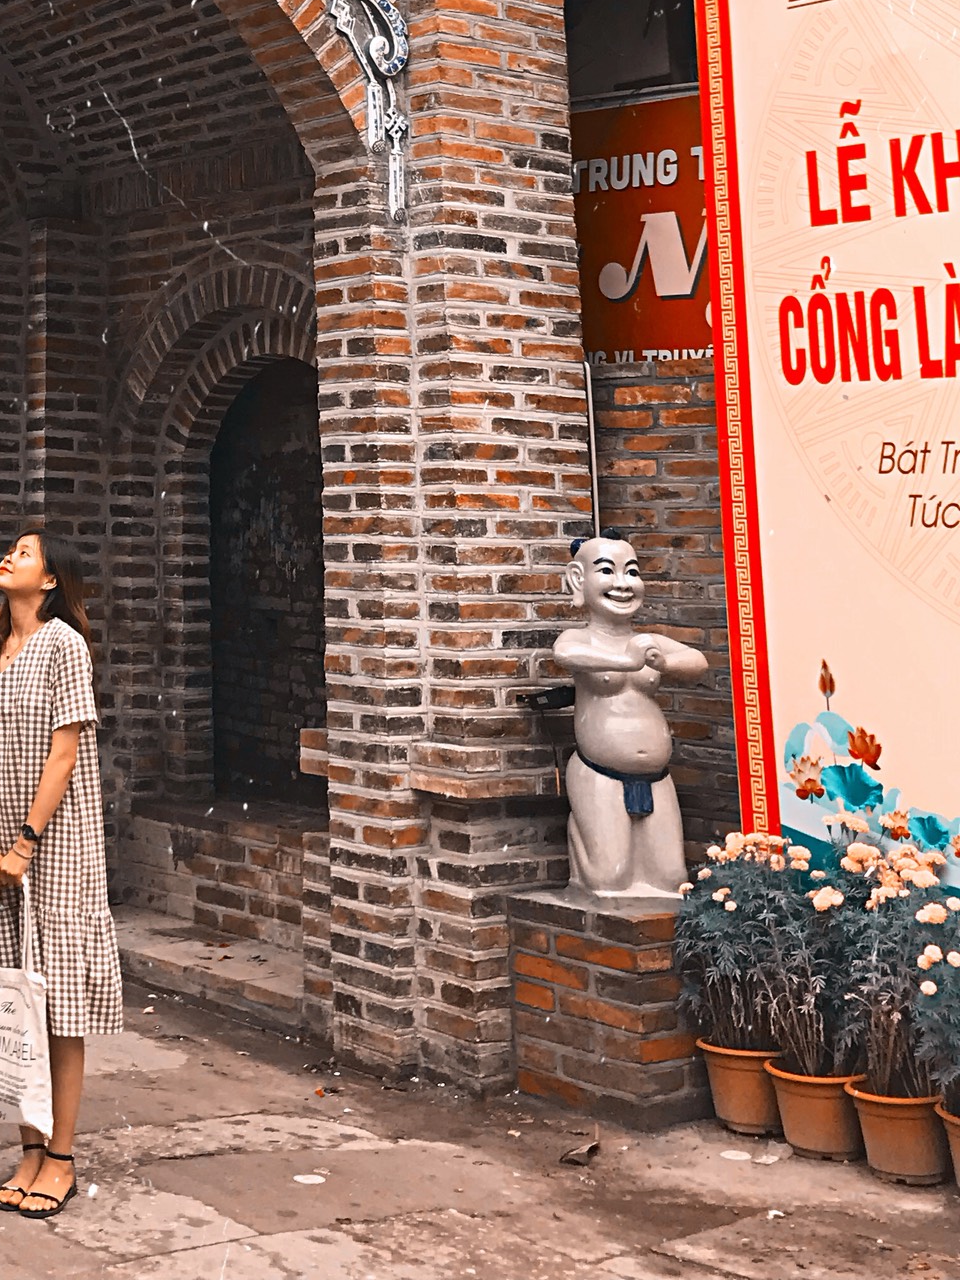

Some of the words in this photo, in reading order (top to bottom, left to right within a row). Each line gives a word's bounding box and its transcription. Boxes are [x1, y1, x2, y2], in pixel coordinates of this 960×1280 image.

[573, 149, 678, 194] TRUNG
[805, 99, 872, 227] LỄ
[889, 129, 960, 218] KH
[778, 256, 903, 386] CỔNG
[878, 440, 931, 474] Bát
[908, 494, 960, 529] Tức
